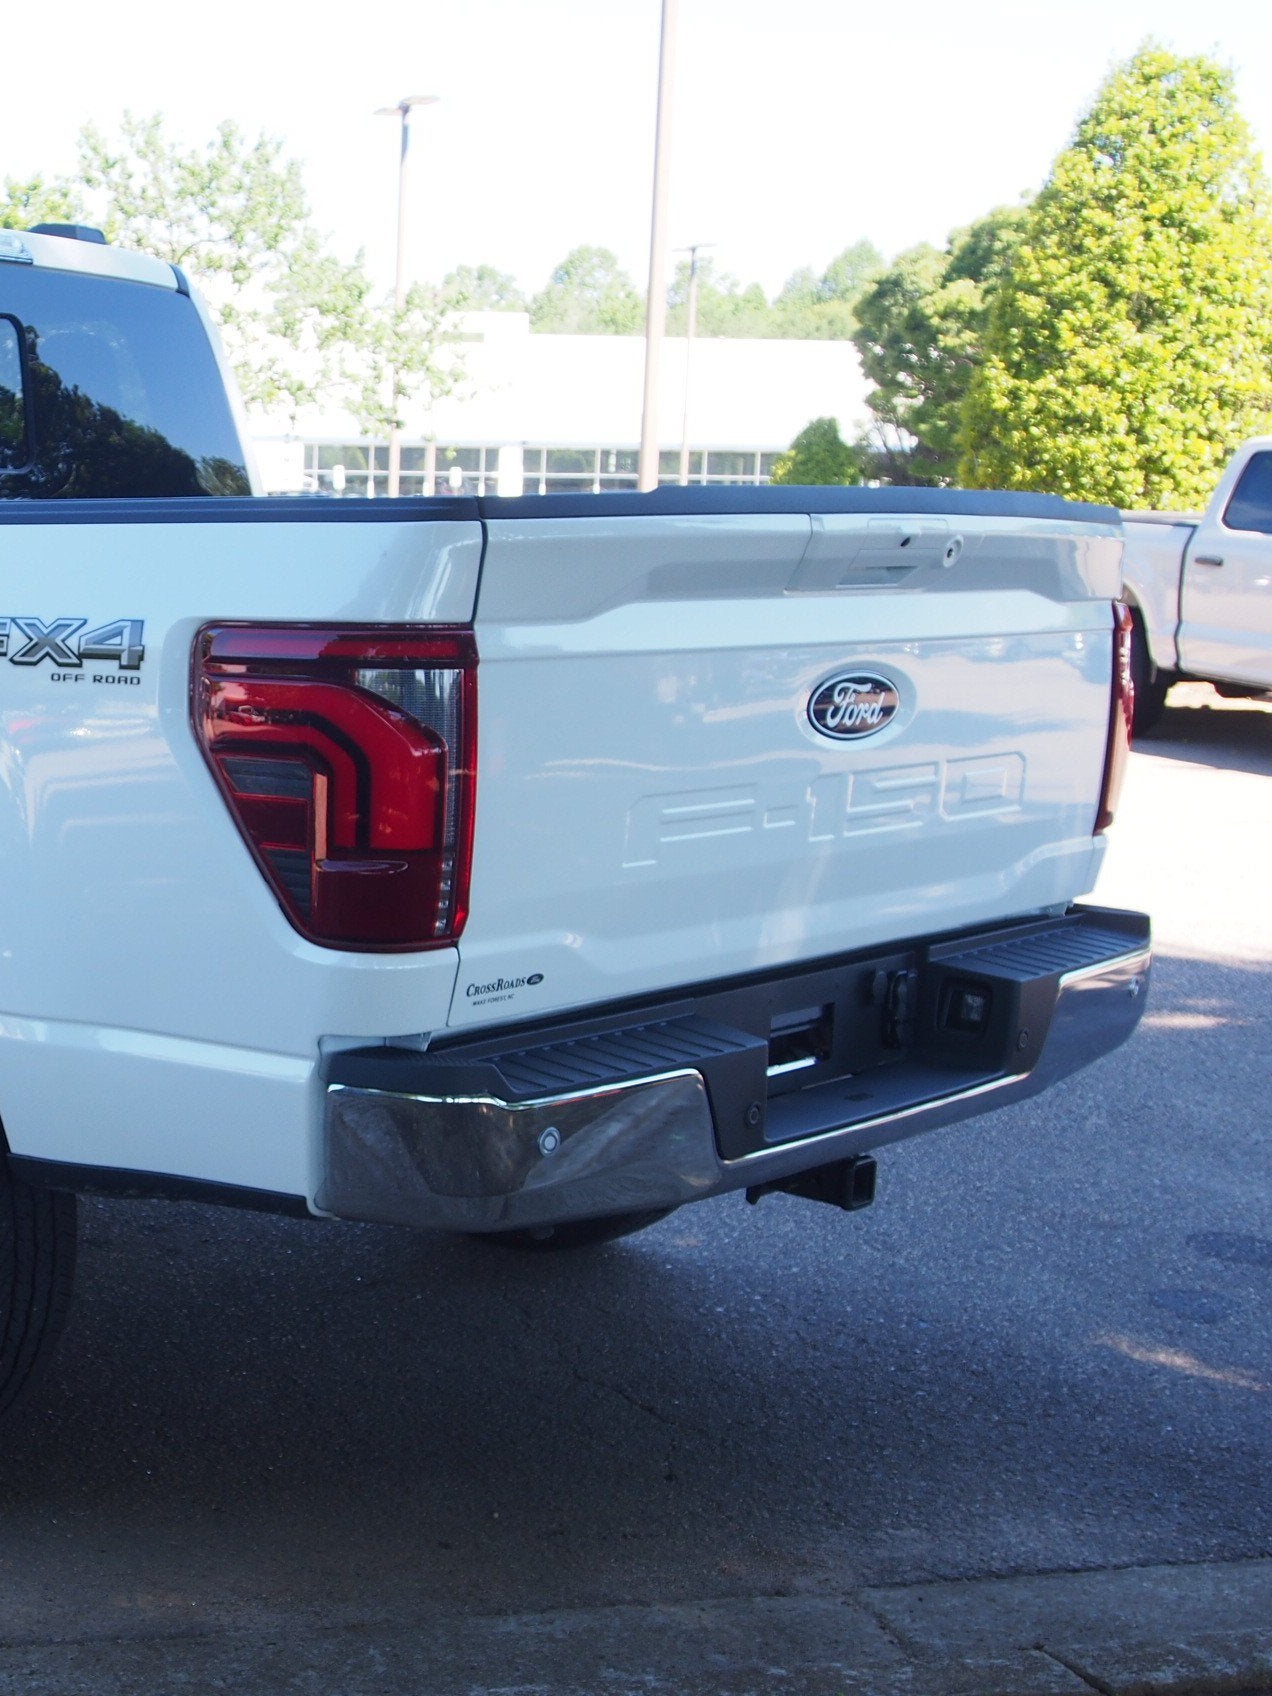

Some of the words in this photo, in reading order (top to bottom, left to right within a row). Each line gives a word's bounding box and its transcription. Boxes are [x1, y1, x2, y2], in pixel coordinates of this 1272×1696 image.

[50, 672, 85, 683] OFF
[92, 674, 141, 686] ROAD
[827, 681, 885, 727] Ford
[621, 750, 1027, 868] F-150
